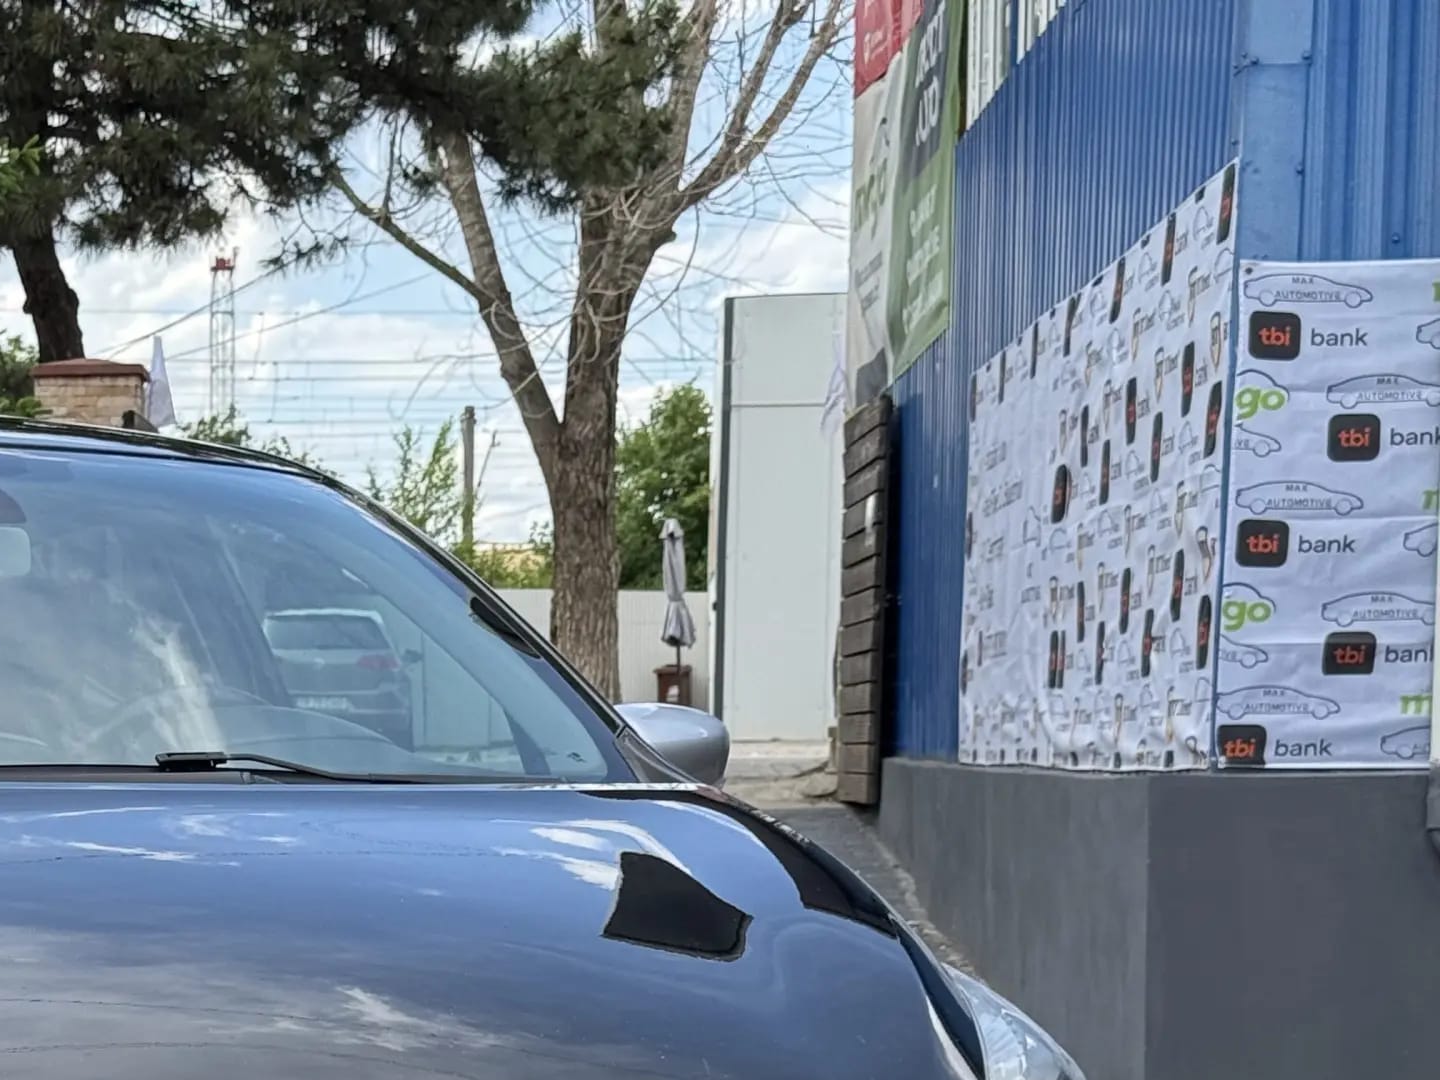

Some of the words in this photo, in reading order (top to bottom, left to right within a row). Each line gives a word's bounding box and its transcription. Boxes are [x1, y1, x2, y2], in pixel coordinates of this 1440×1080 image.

[1274, 290, 1341, 300] AUTOMOTIVE
[1258, 326, 1291, 346] tbi
[1311, 328, 1368, 347] bank
[1338, 427, 1371, 447] tbi
[1246, 535, 1280, 553] tbi
[1298, 535, 1355, 554] bank
[1222, 600, 1271, 631] go
[1333, 645, 1366, 664] tbi
[1224, 739, 1257, 757] tbi
[1274, 739, 1333, 757] bank
